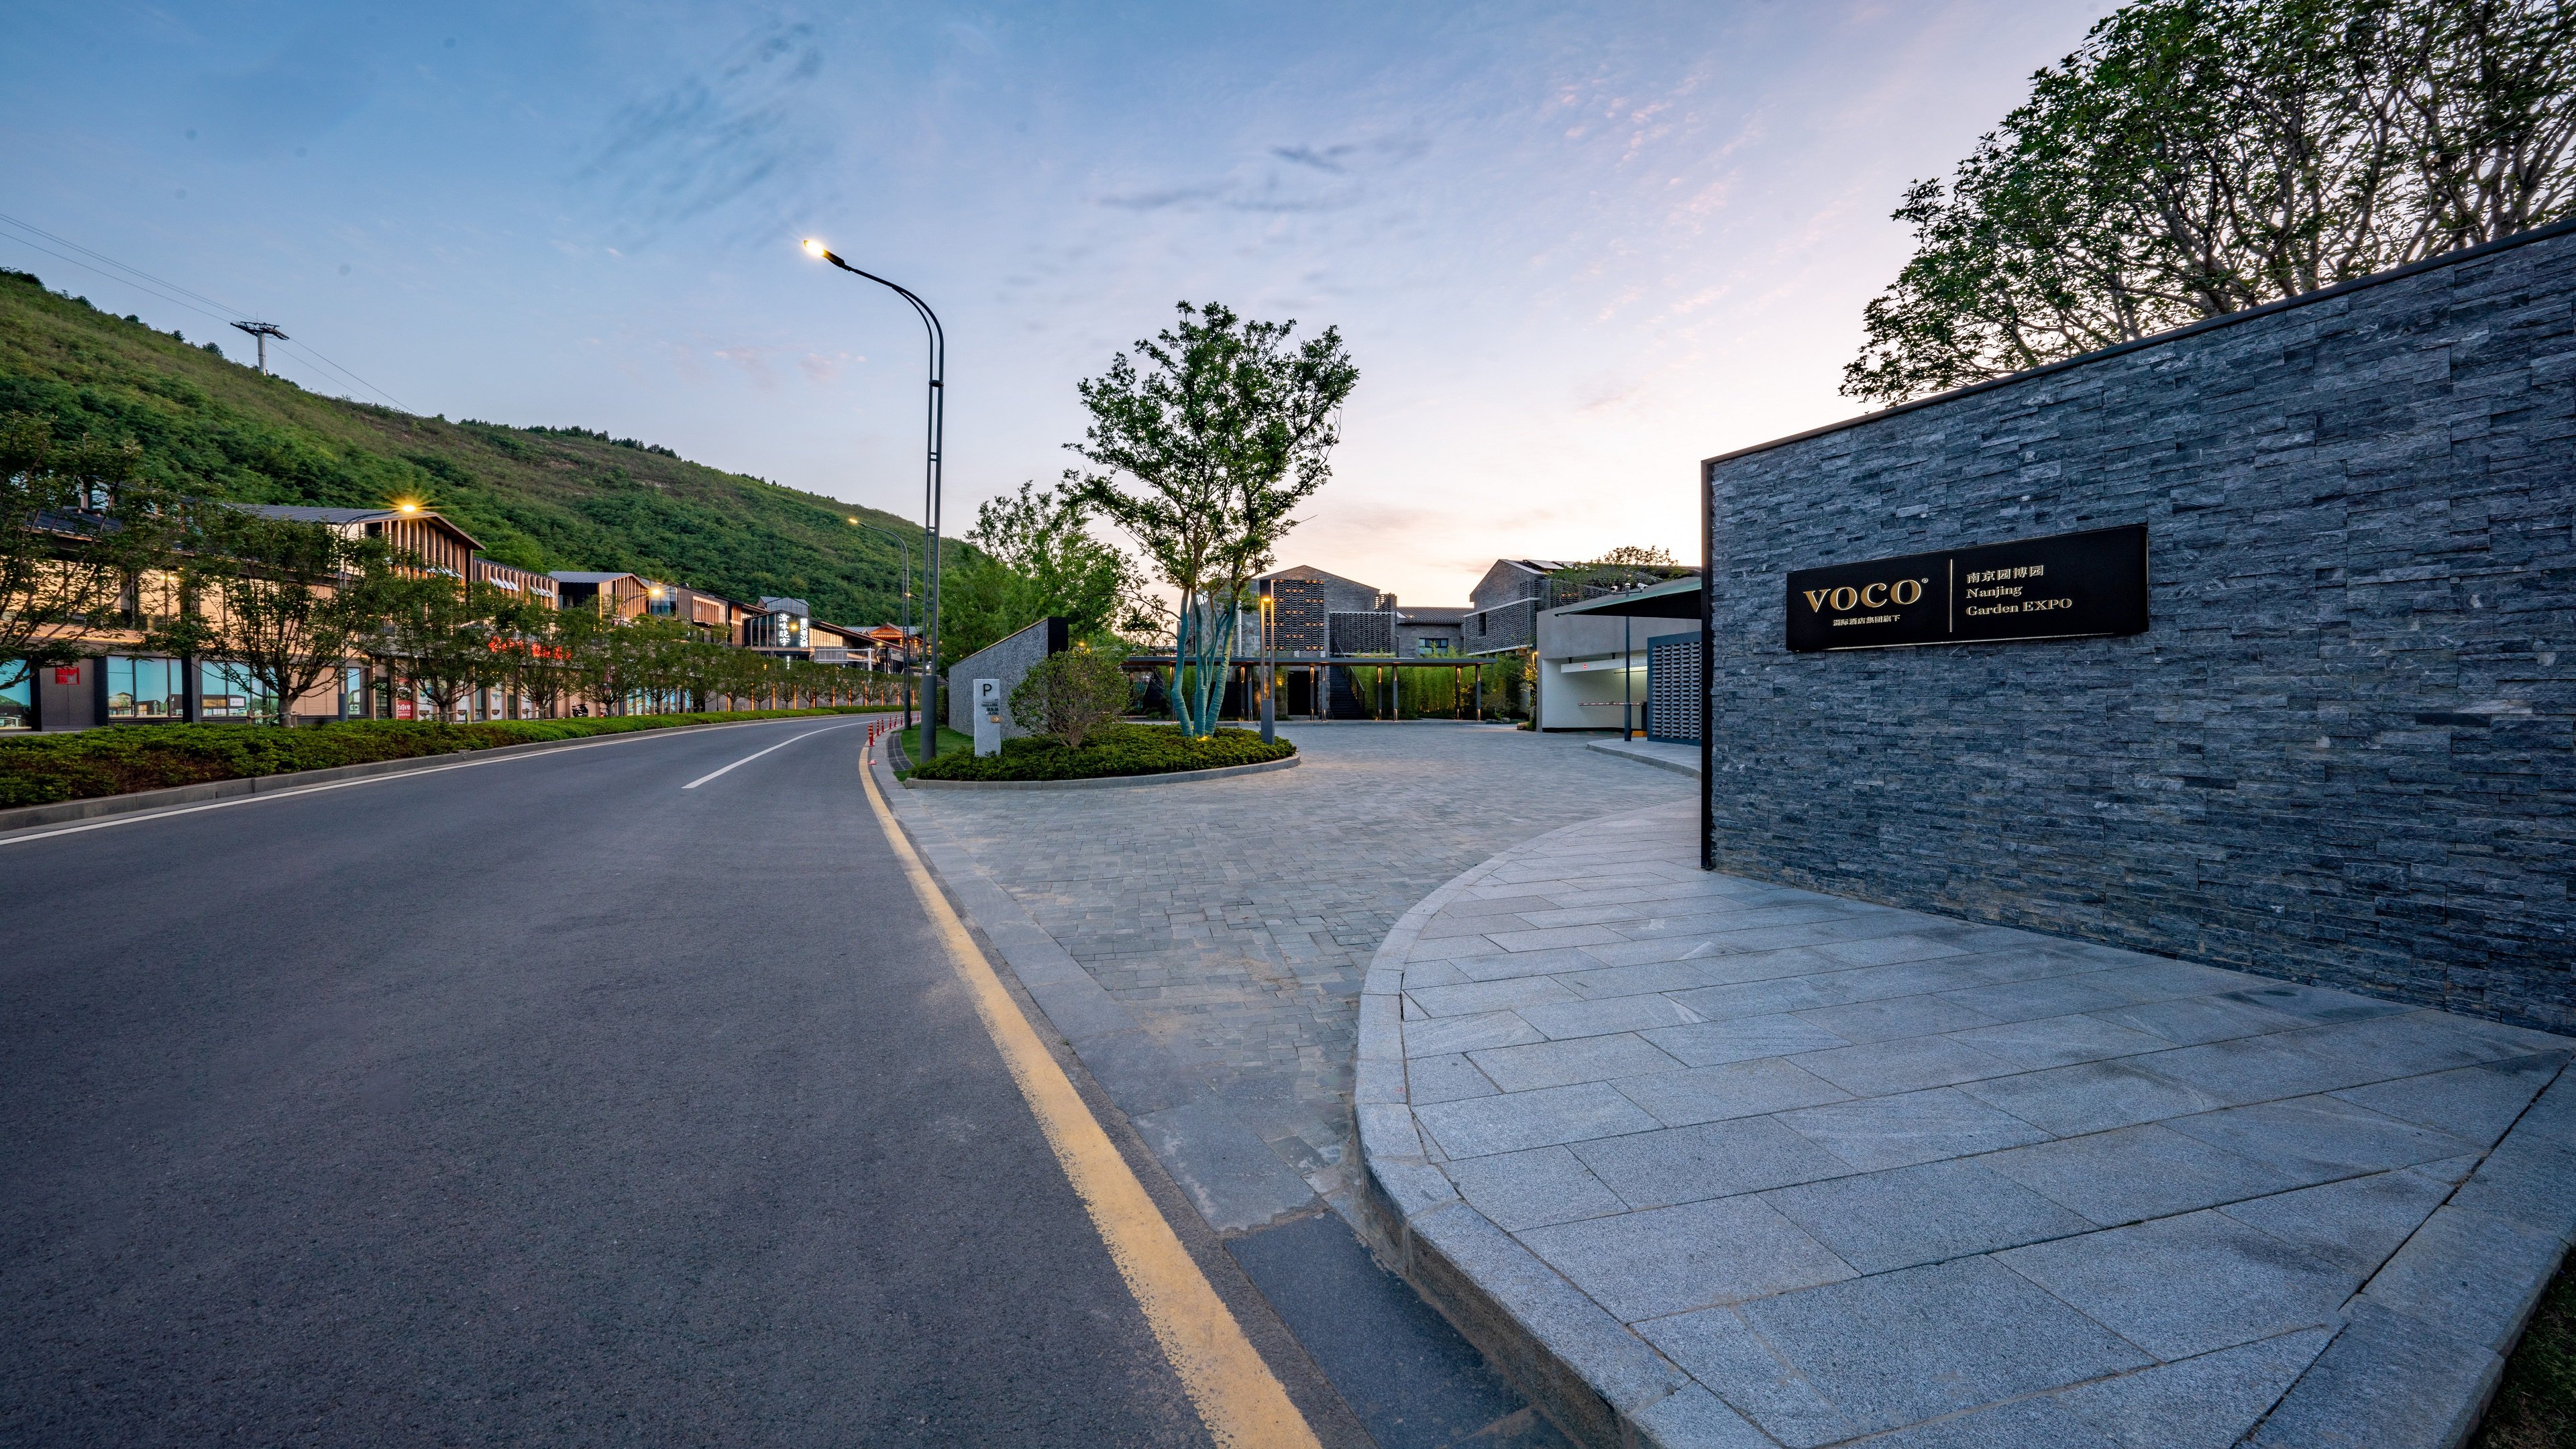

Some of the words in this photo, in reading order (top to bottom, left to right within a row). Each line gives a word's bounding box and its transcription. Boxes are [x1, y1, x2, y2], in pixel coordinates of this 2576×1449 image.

[1966, 565, 2044, 584] 南京园博园
[1966, 586, 2023, 598] Nanjing
[1966, 603, 2019, 616] Garden
[2023, 598, 2073, 612] EXPO
[1832, 614, 1901, 627] 洲际酒店集团旗下
[983, 683, 992, 696] P
